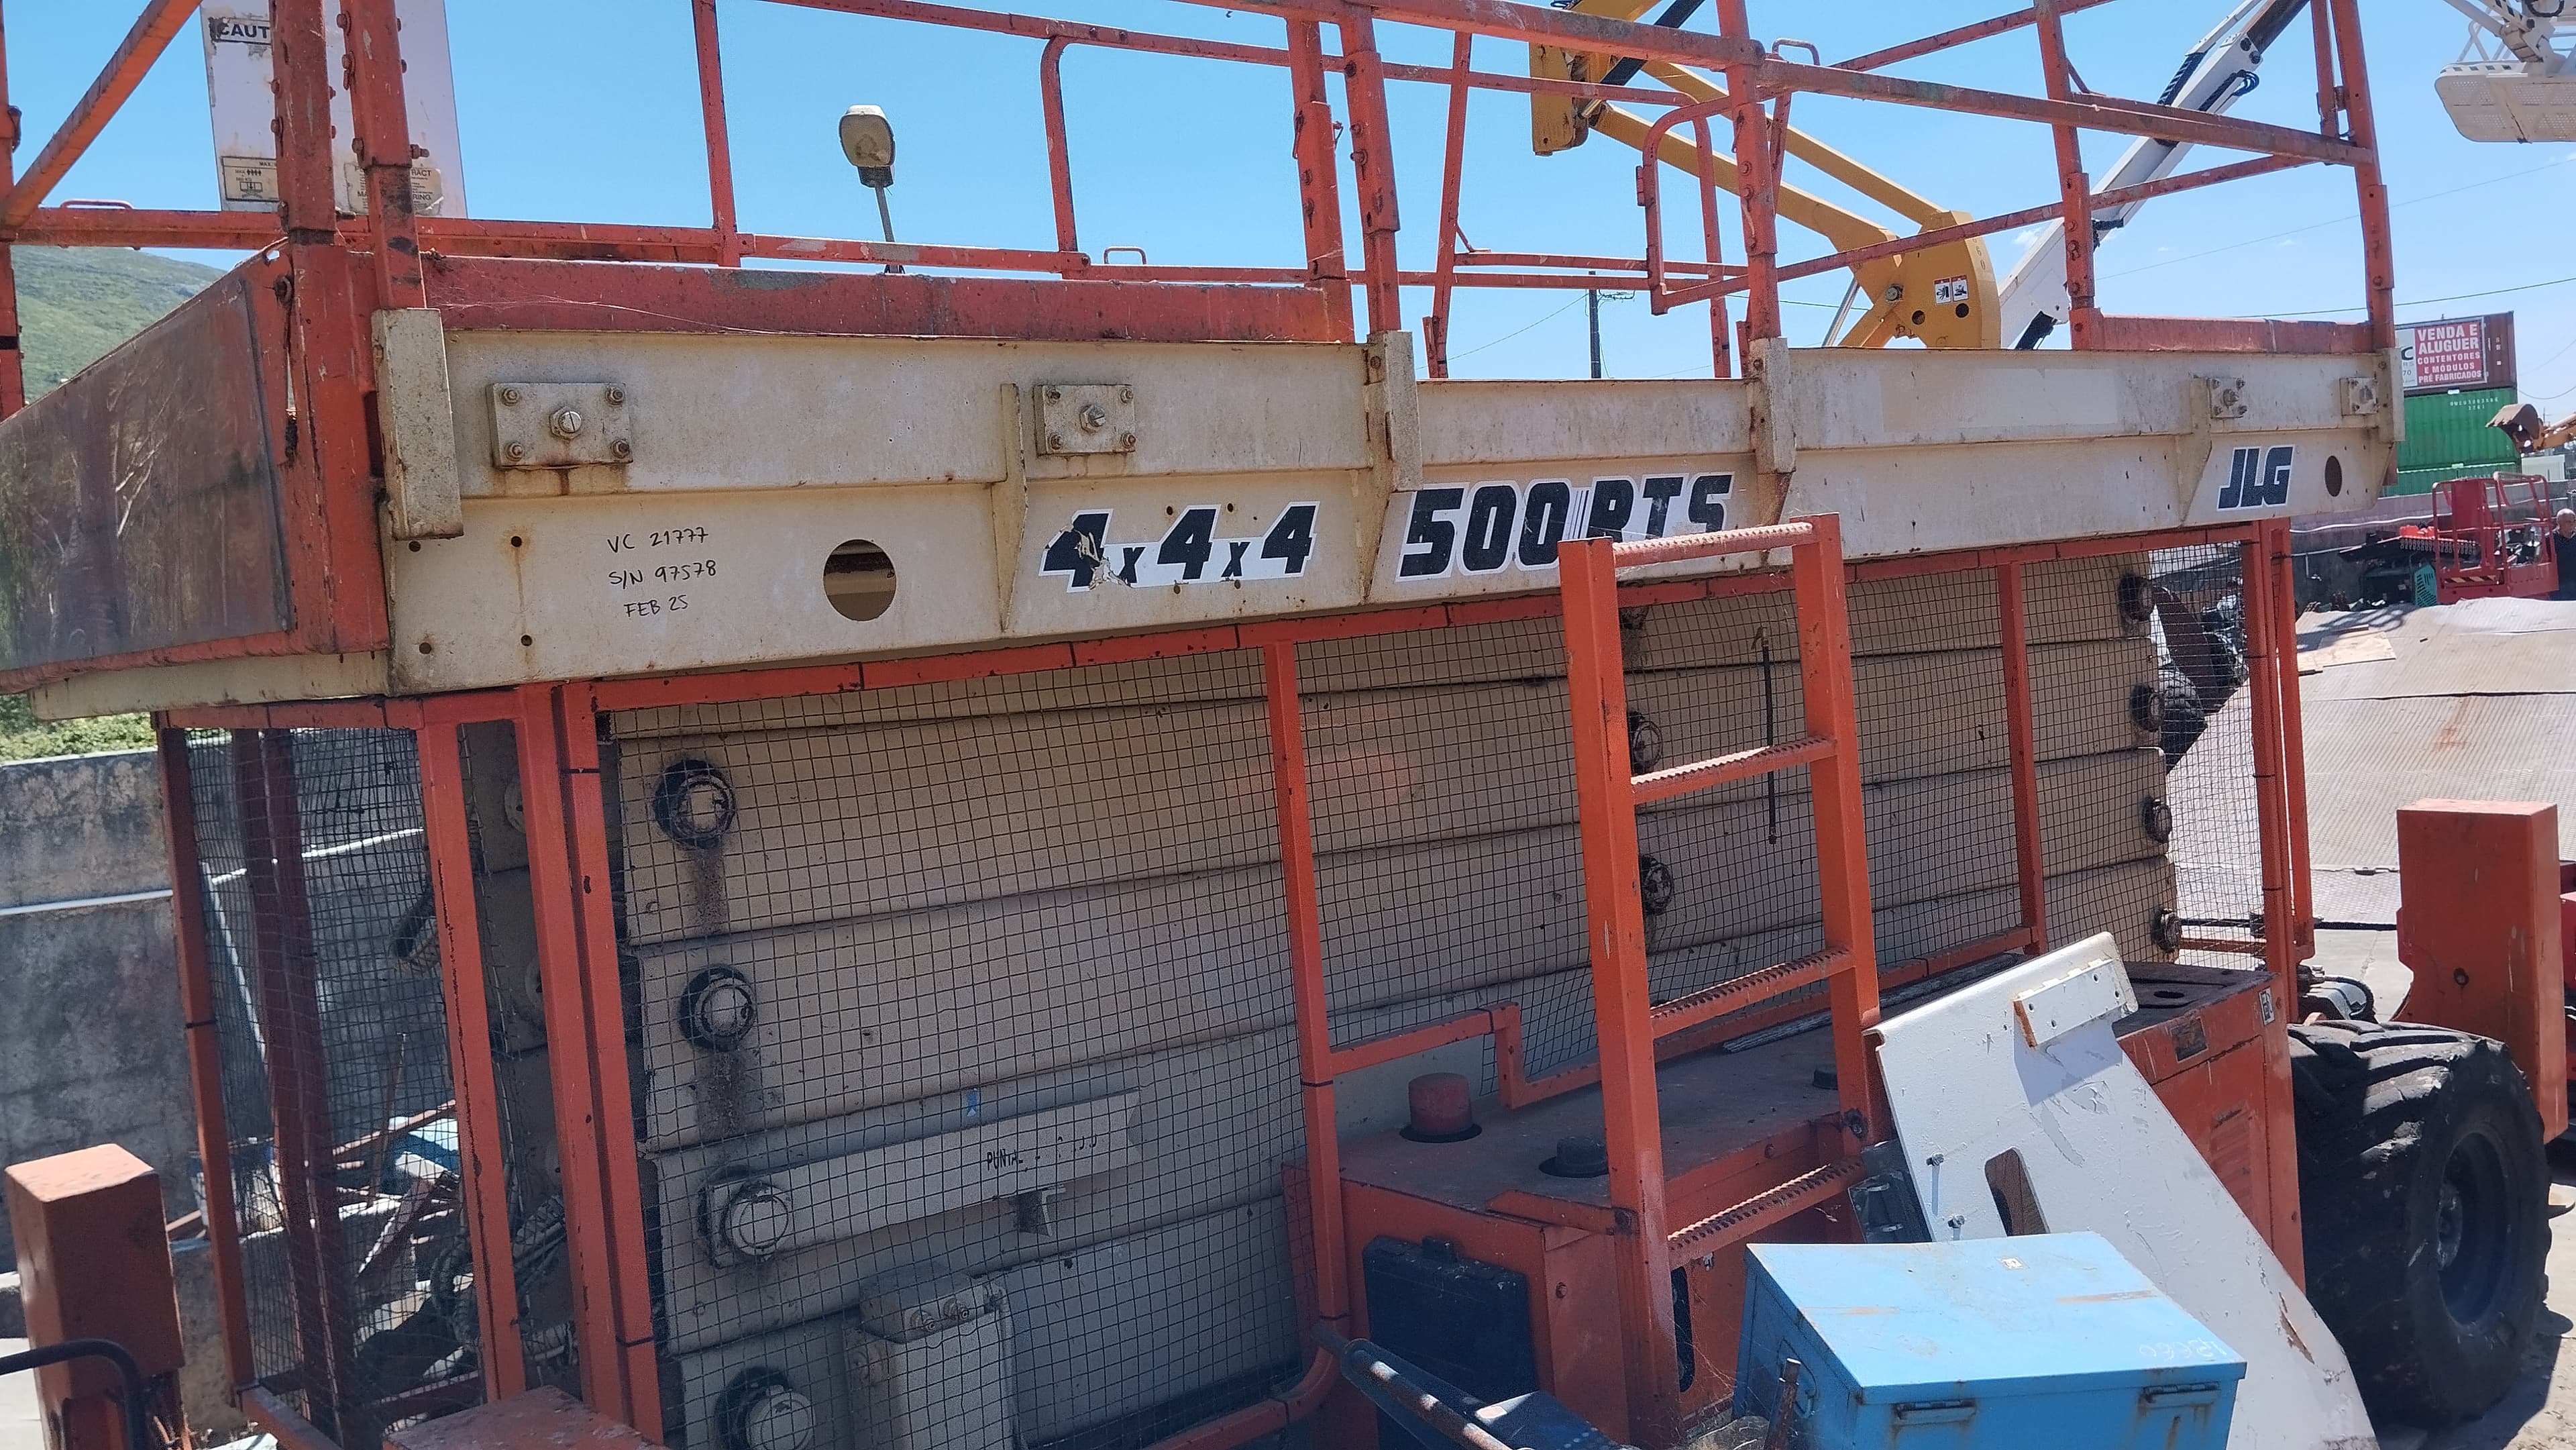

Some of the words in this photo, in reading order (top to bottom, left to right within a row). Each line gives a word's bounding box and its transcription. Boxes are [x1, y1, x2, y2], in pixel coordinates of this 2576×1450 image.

[2417, 325, 2465, 342] VENDA
[2469, 323, 2477, 336] E
[2418, 337, 2479, 355] ALUGUER
[2417, 352, 2481, 364] CONTENTORES
[2418, 374, 2434, 383] PRÉ
[2435, 370, 2482, 382] FABRICADOS
[2432, 362, 2475, 373] MÓDULOS
[2217, 446, 2294, 509] JLG
[1398, 480, 1571, 578] 500
[606, 533, 635, 553] VC
[649, 526, 709, 547] 21777
[608, 570, 644, 590] S/N
[654, 559, 716, 583] 97578
[623, 599, 661, 617] FEB
